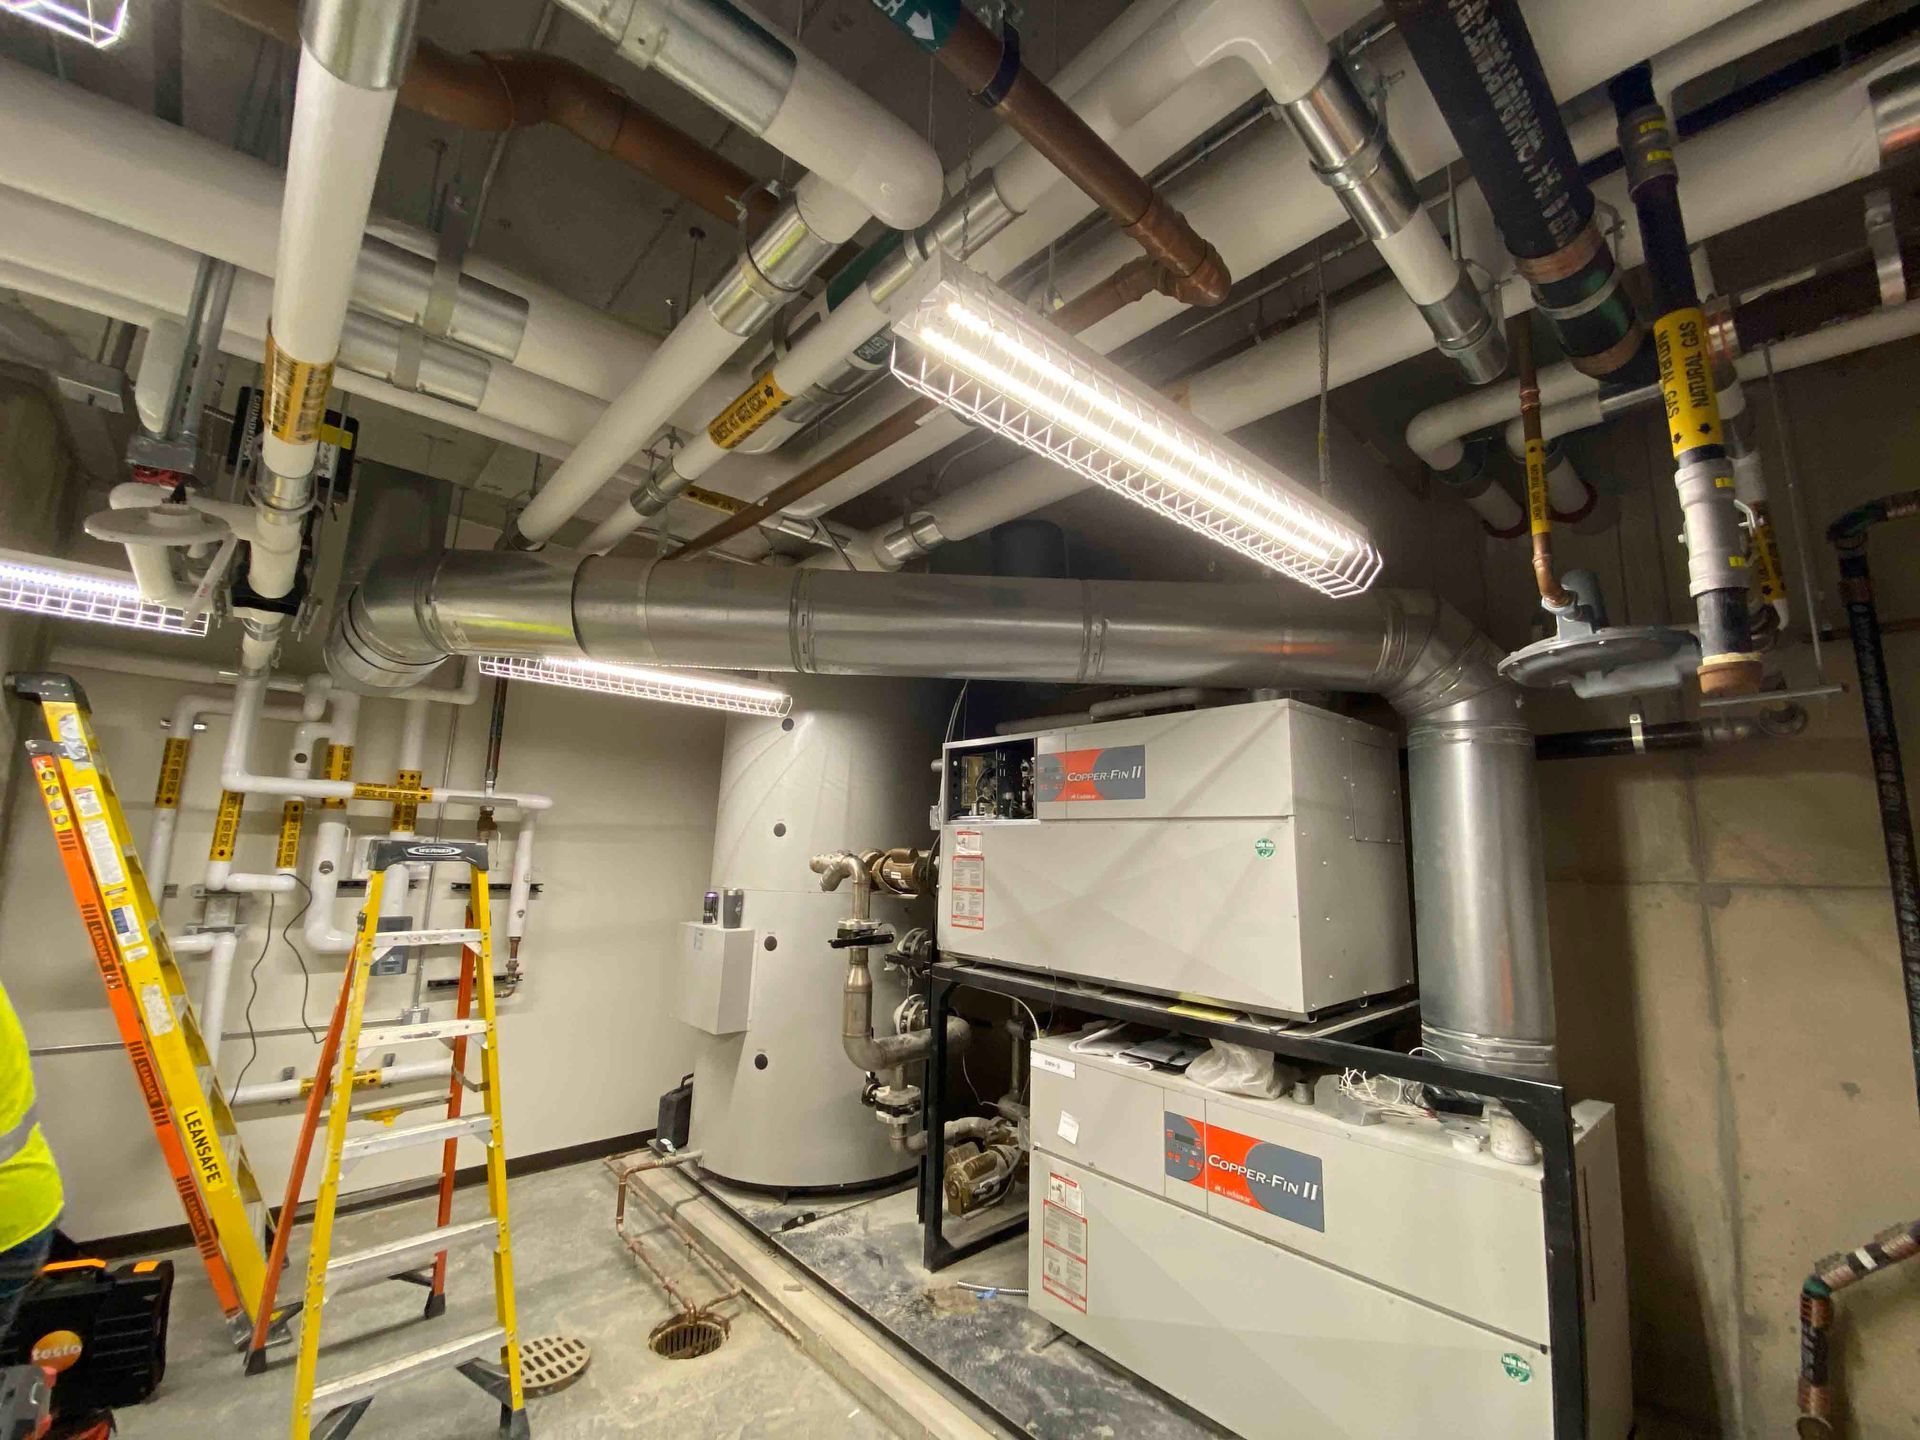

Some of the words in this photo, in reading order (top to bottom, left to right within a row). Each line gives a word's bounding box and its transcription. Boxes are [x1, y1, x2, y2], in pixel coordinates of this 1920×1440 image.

[1678, 321, 1699, 348] GAS
[1656, 329, 1675, 390] NATURAL
[1684, 351, 1710, 409] NATURAL
[1665, 390, 1680, 419] GAS
[1067, 769, 1130, 782] COPPER-FIN
[183, 1110, 221, 1184] LEANSAFE
[1207, 1154, 1299, 1195] COPPER-FIN
[1302, 1181, 1319, 1201] II
[31, 1344, 83, 1362] testo
